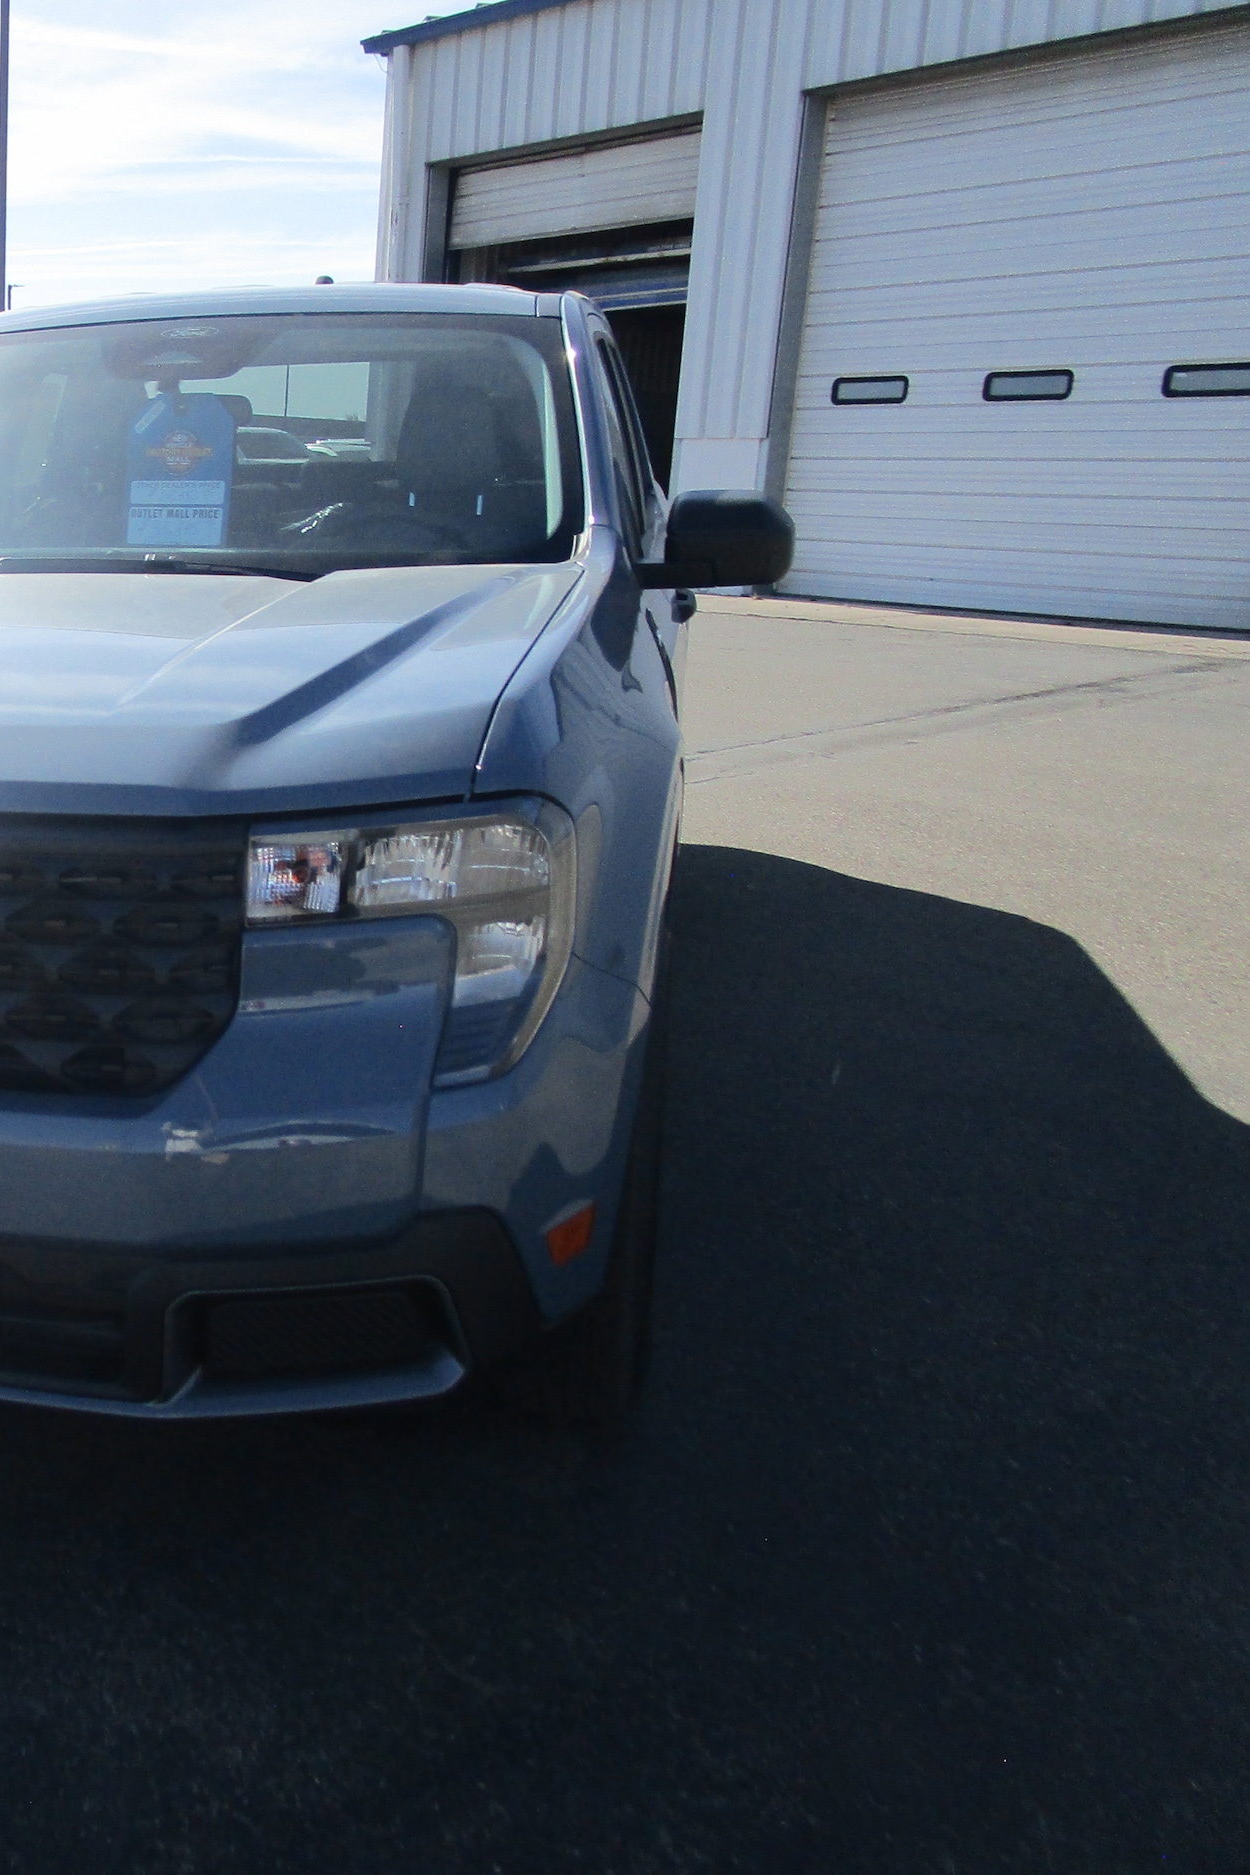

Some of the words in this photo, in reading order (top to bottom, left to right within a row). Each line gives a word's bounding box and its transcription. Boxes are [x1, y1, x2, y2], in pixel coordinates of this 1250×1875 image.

[131, 509, 163, 518] OUTLET
[167, 509, 190, 519] MALL
[193, 510, 219, 519] PRICE
